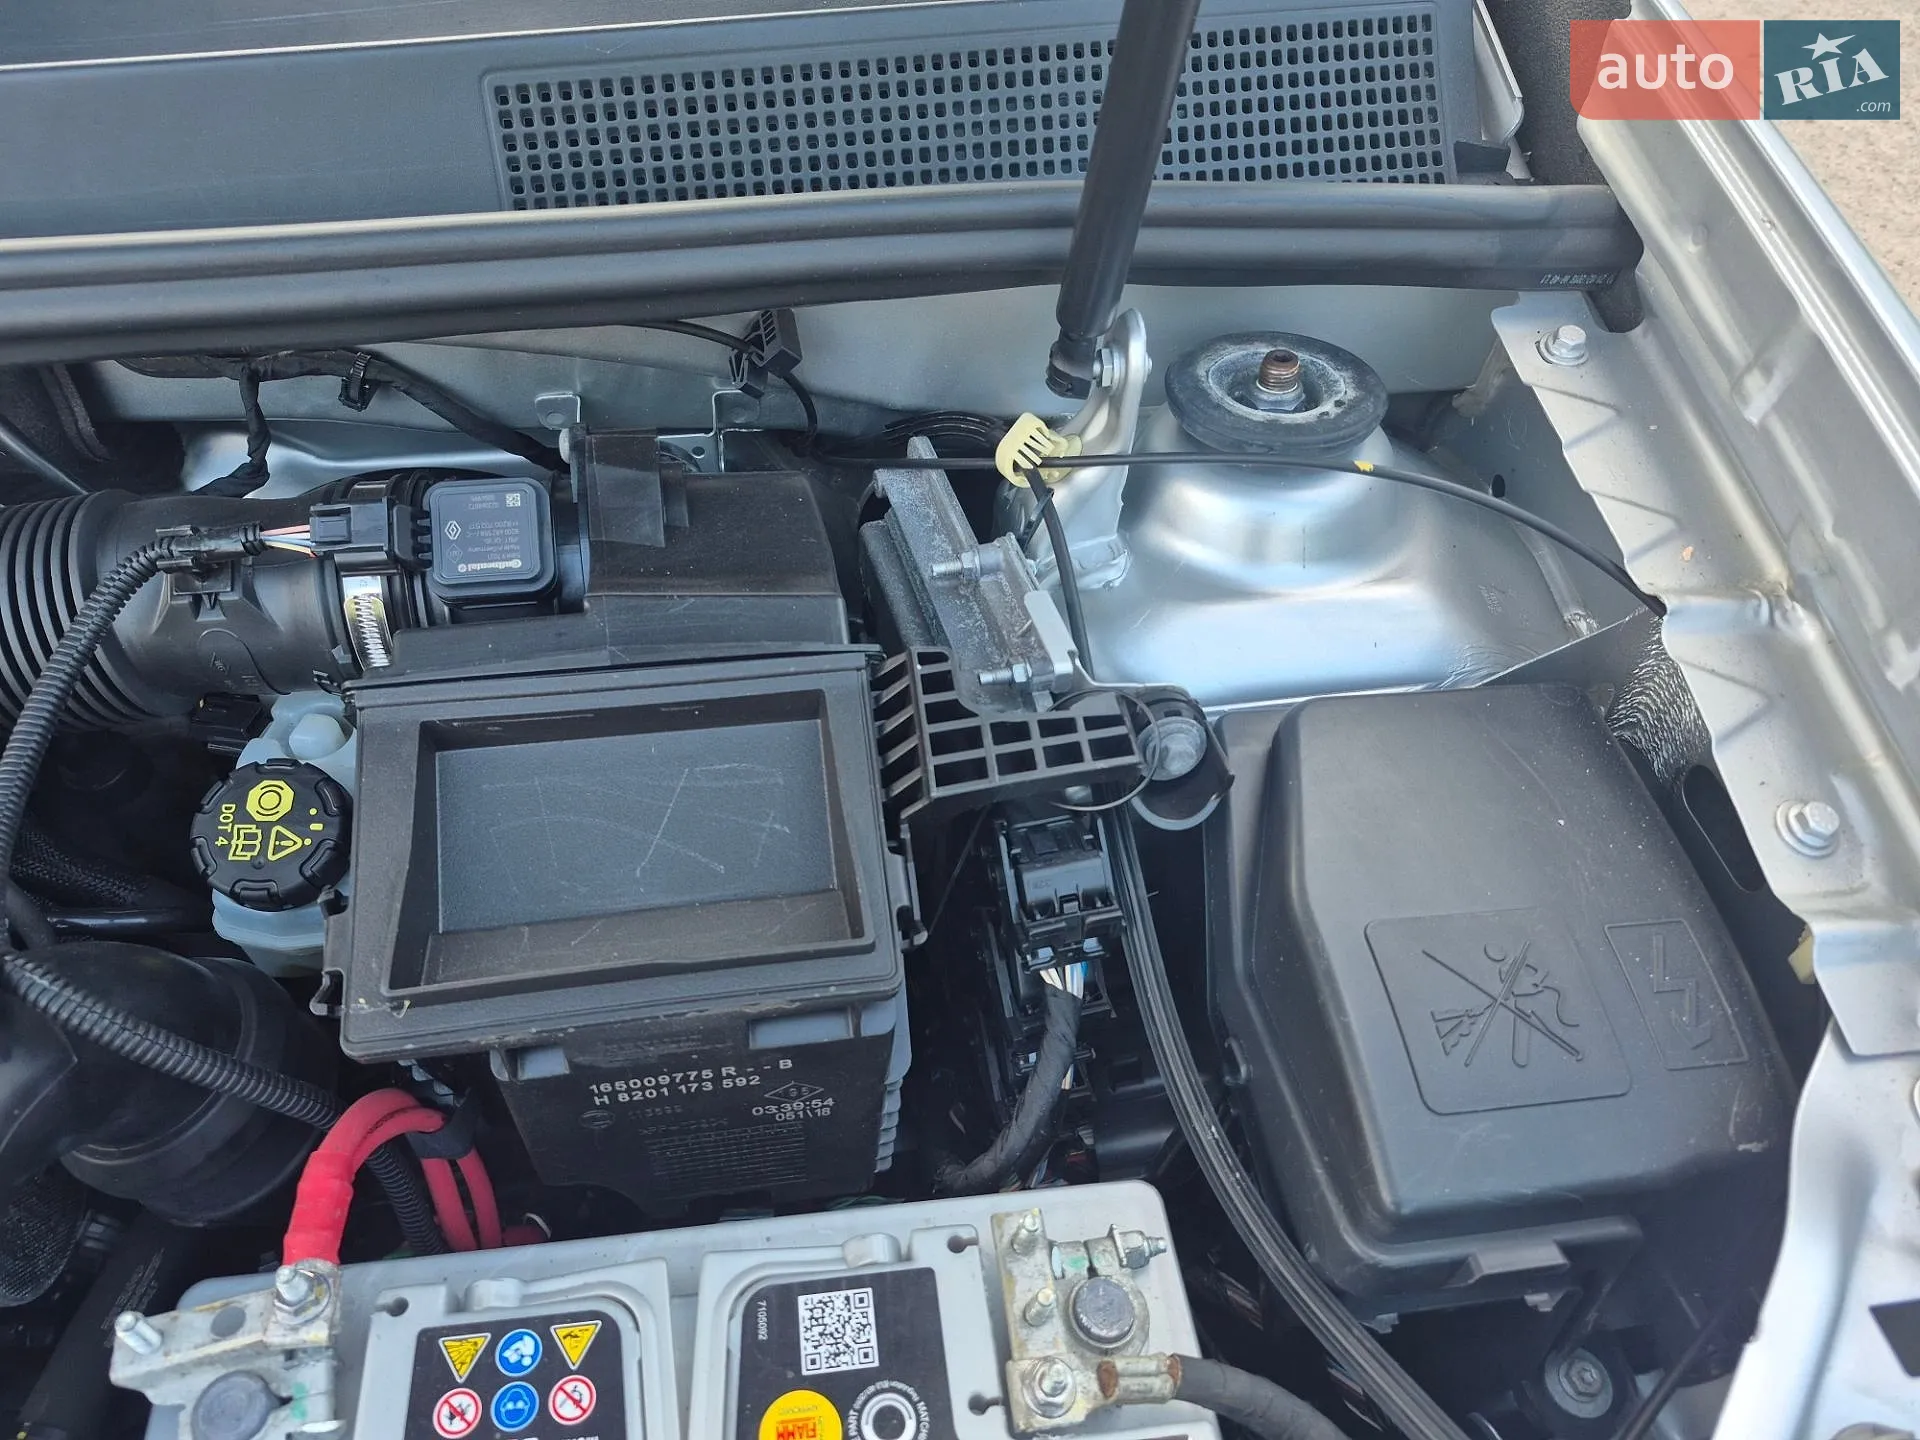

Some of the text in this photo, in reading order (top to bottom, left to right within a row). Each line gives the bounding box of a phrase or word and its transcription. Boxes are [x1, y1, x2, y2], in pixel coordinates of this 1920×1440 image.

[214, 803, 236, 847] DOT 4
[588, 1068, 714, 1094] 165009775
[721, 1066, 737, 1077] R
[779, 1059, 793, 1070] B
[593, 1075, 761, 1106] H 8201 173 592
